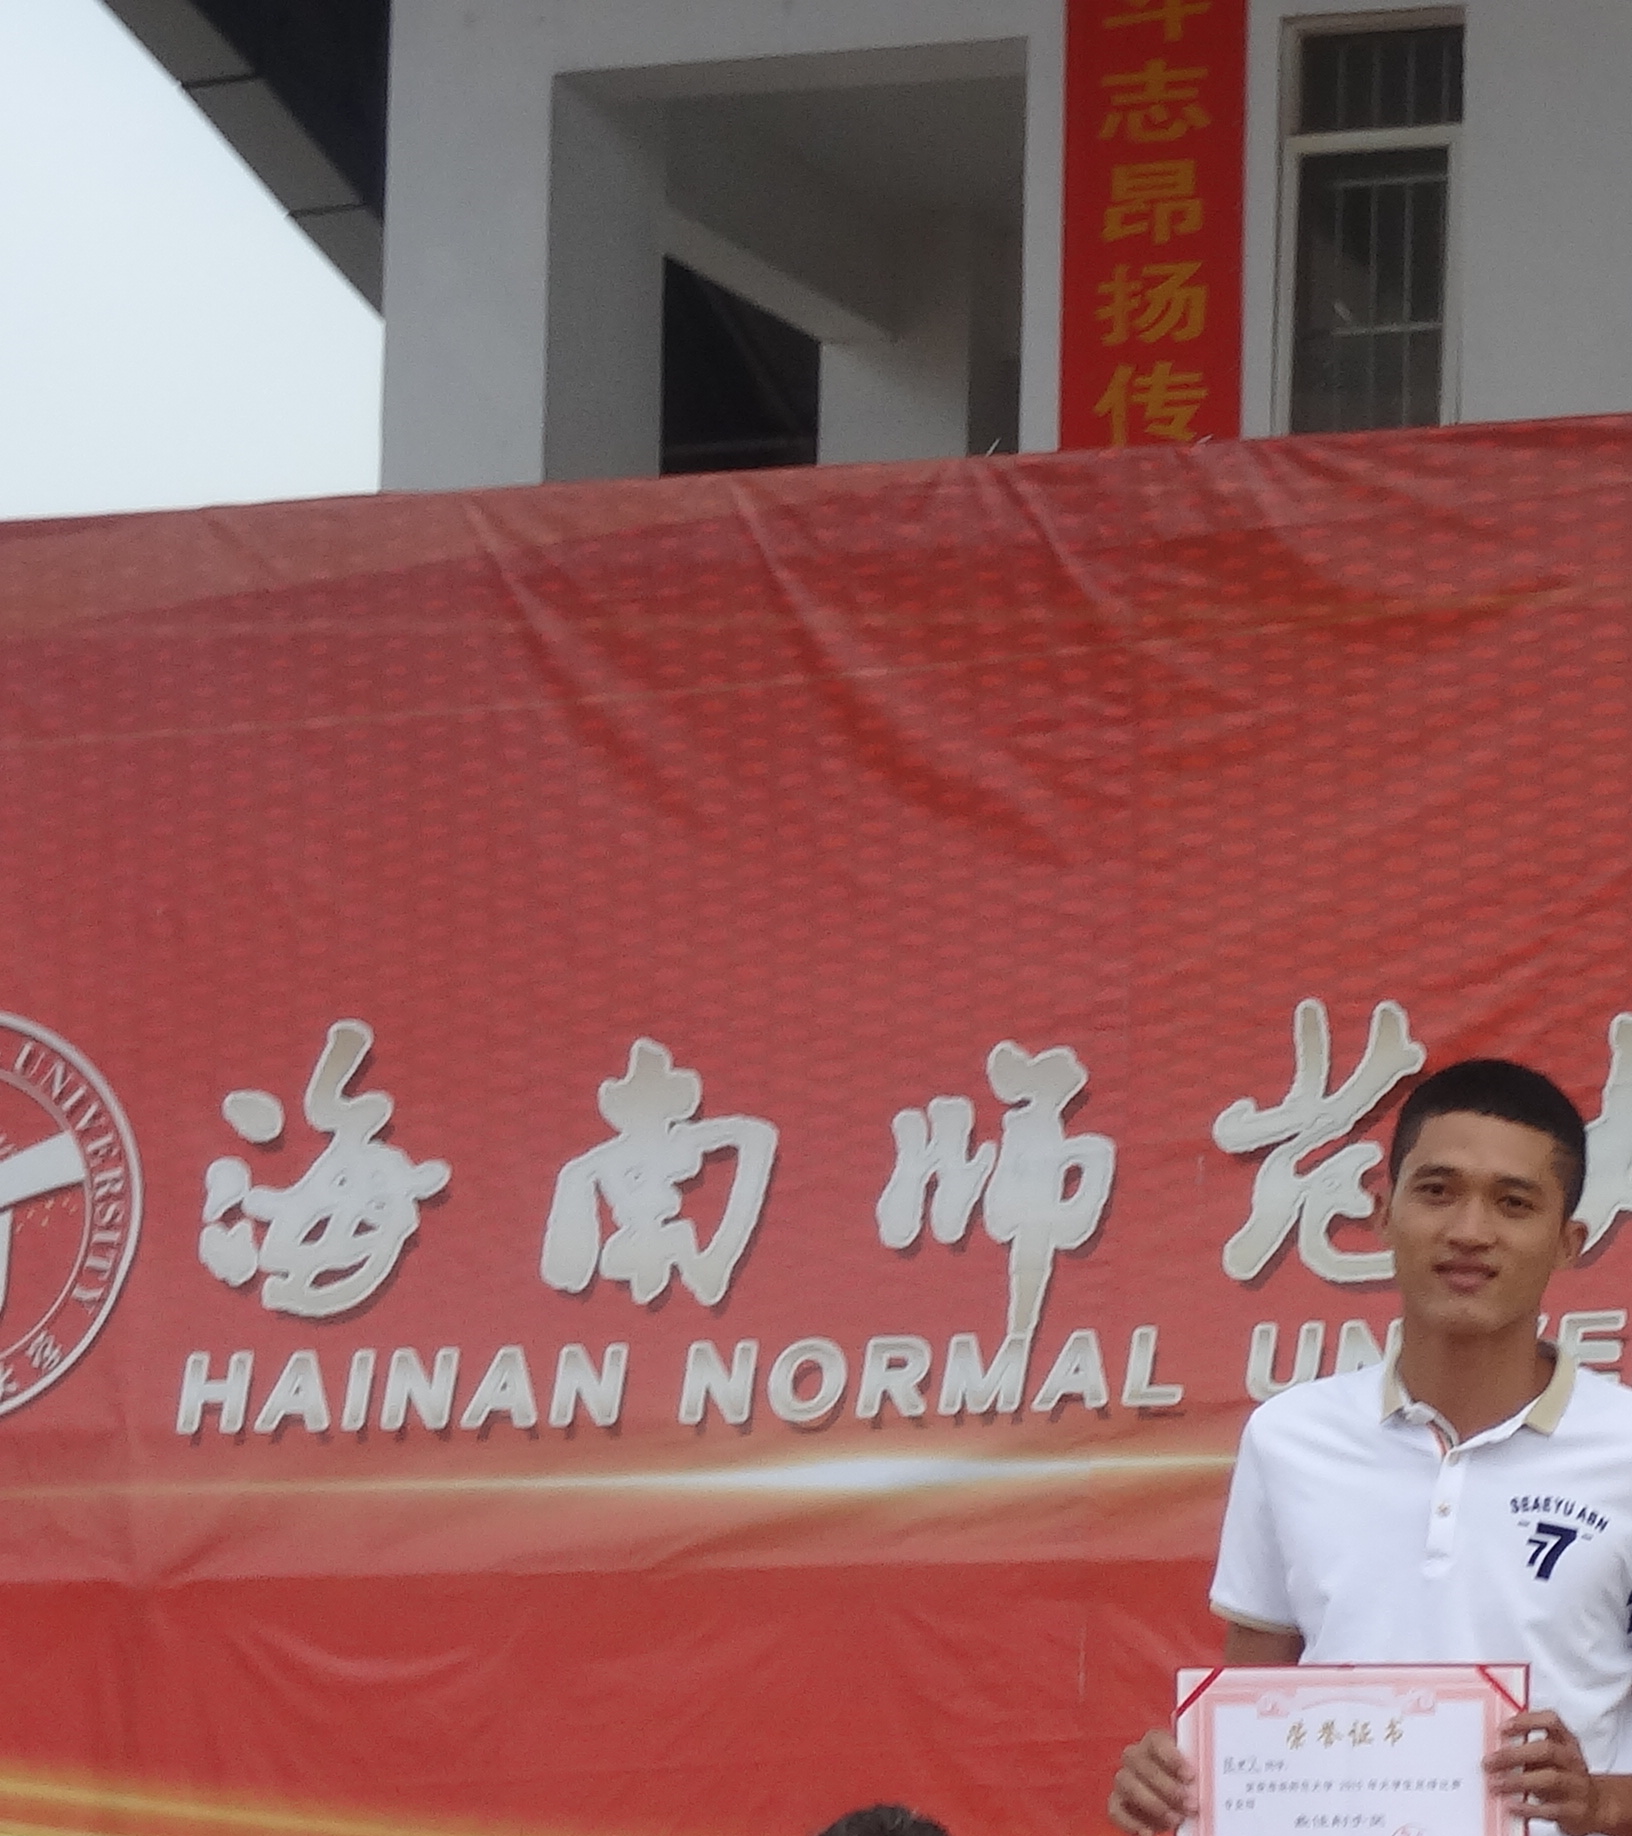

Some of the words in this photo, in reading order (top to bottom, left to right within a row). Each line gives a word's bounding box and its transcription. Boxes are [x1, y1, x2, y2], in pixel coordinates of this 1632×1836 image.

[14, 1040, 128, 1316] UNIVERSITY
[176, 1342, 628, 1436] HAINAN
[678, 1324, 1184, 1425] NORMAL
